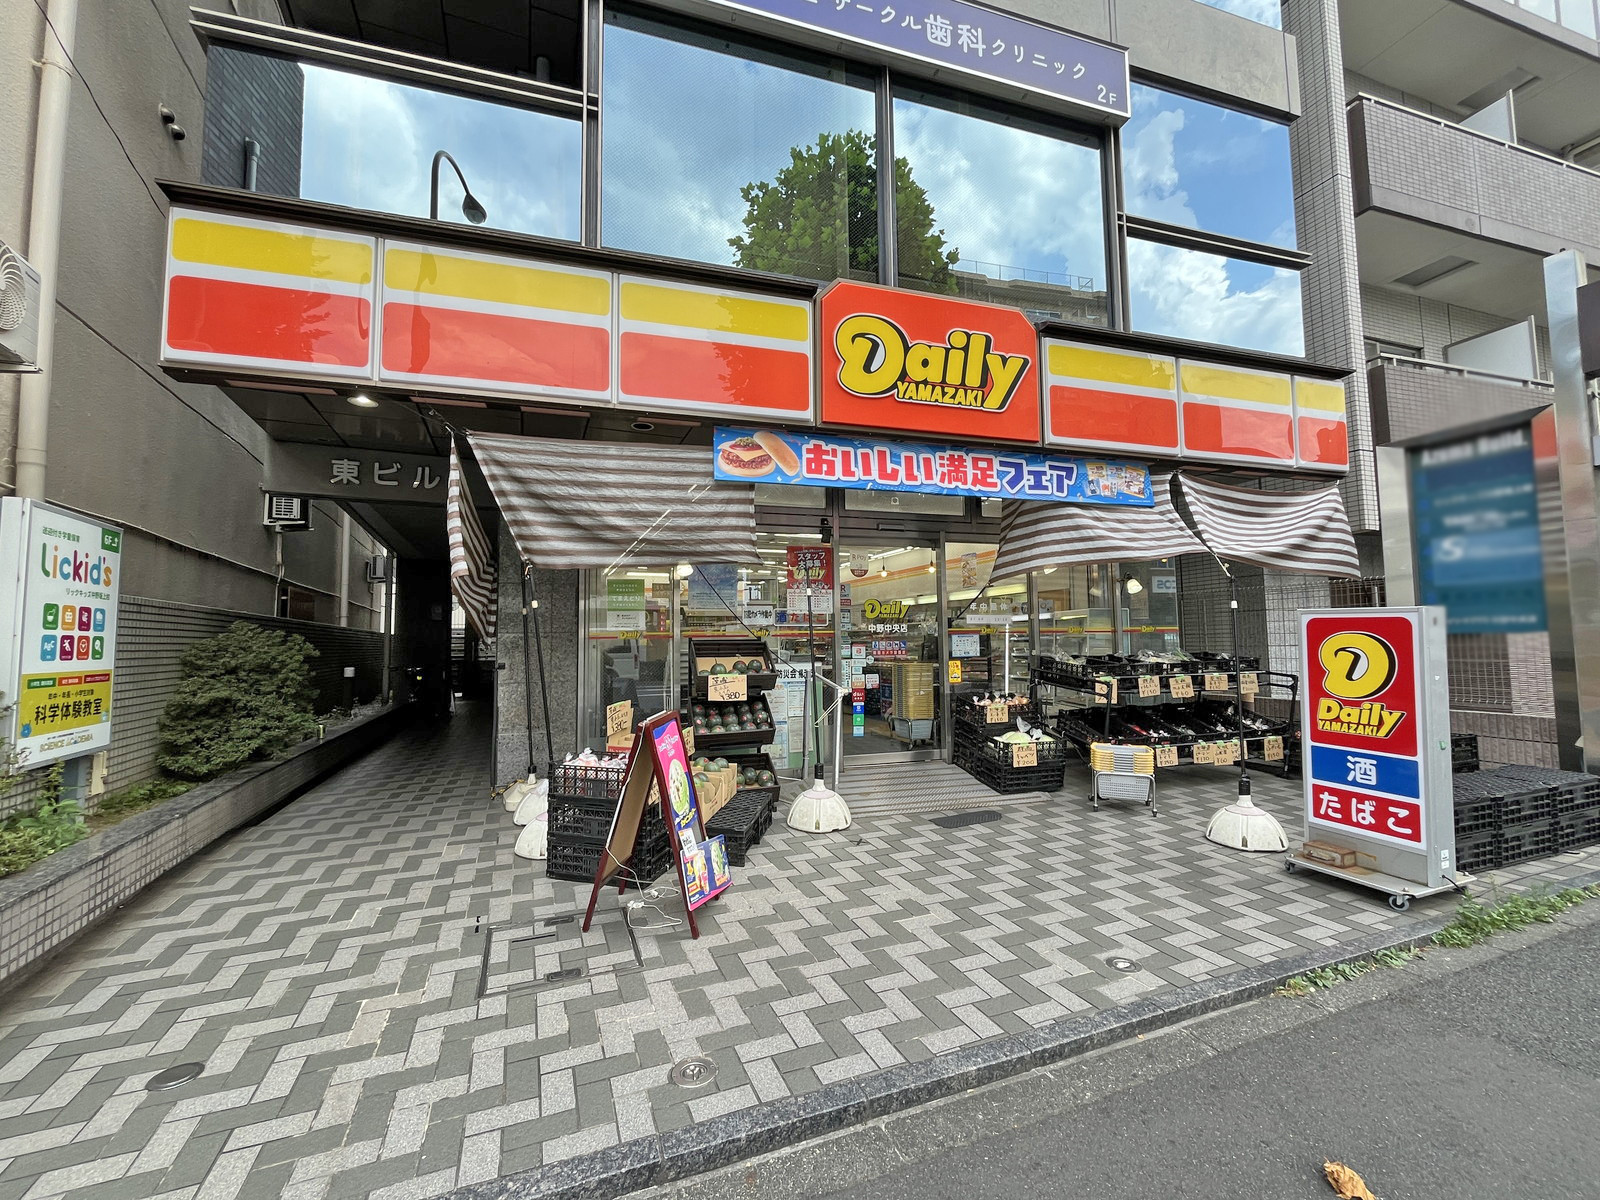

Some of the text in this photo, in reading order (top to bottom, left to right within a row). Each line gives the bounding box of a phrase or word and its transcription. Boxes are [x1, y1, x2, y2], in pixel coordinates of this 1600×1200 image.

[804, 0, 1087, 79] サークル歯科クリニック
[1097, 85, 1117, 105] 2F
[836, 314, 1031, 411] Daily
[897, 381, 983, 407] YAMAZAKI
[331, 459, 440, 489] 東ビル
[803, 440, 1076, 496] おいしい満足フェア
[797, 552, 826, 561] スタッフ
[864, 598, 910, 619] Daily
[970, 602, 1008, 610] 年中無休
[620, 631, 641, 640] Daily
[752, 628, 771, 638] Daily
[868, 623, 908, 633] 中野中央店
[35, 698, 103, 725] 科学体験教室
[1317, 698, 1406, 738] Daily
[1317, 719, 1378, 736] YAMAZAKI
[1346, 754, 1377, 786] 酒
[1319, 791, 1413, 835] たばこ
